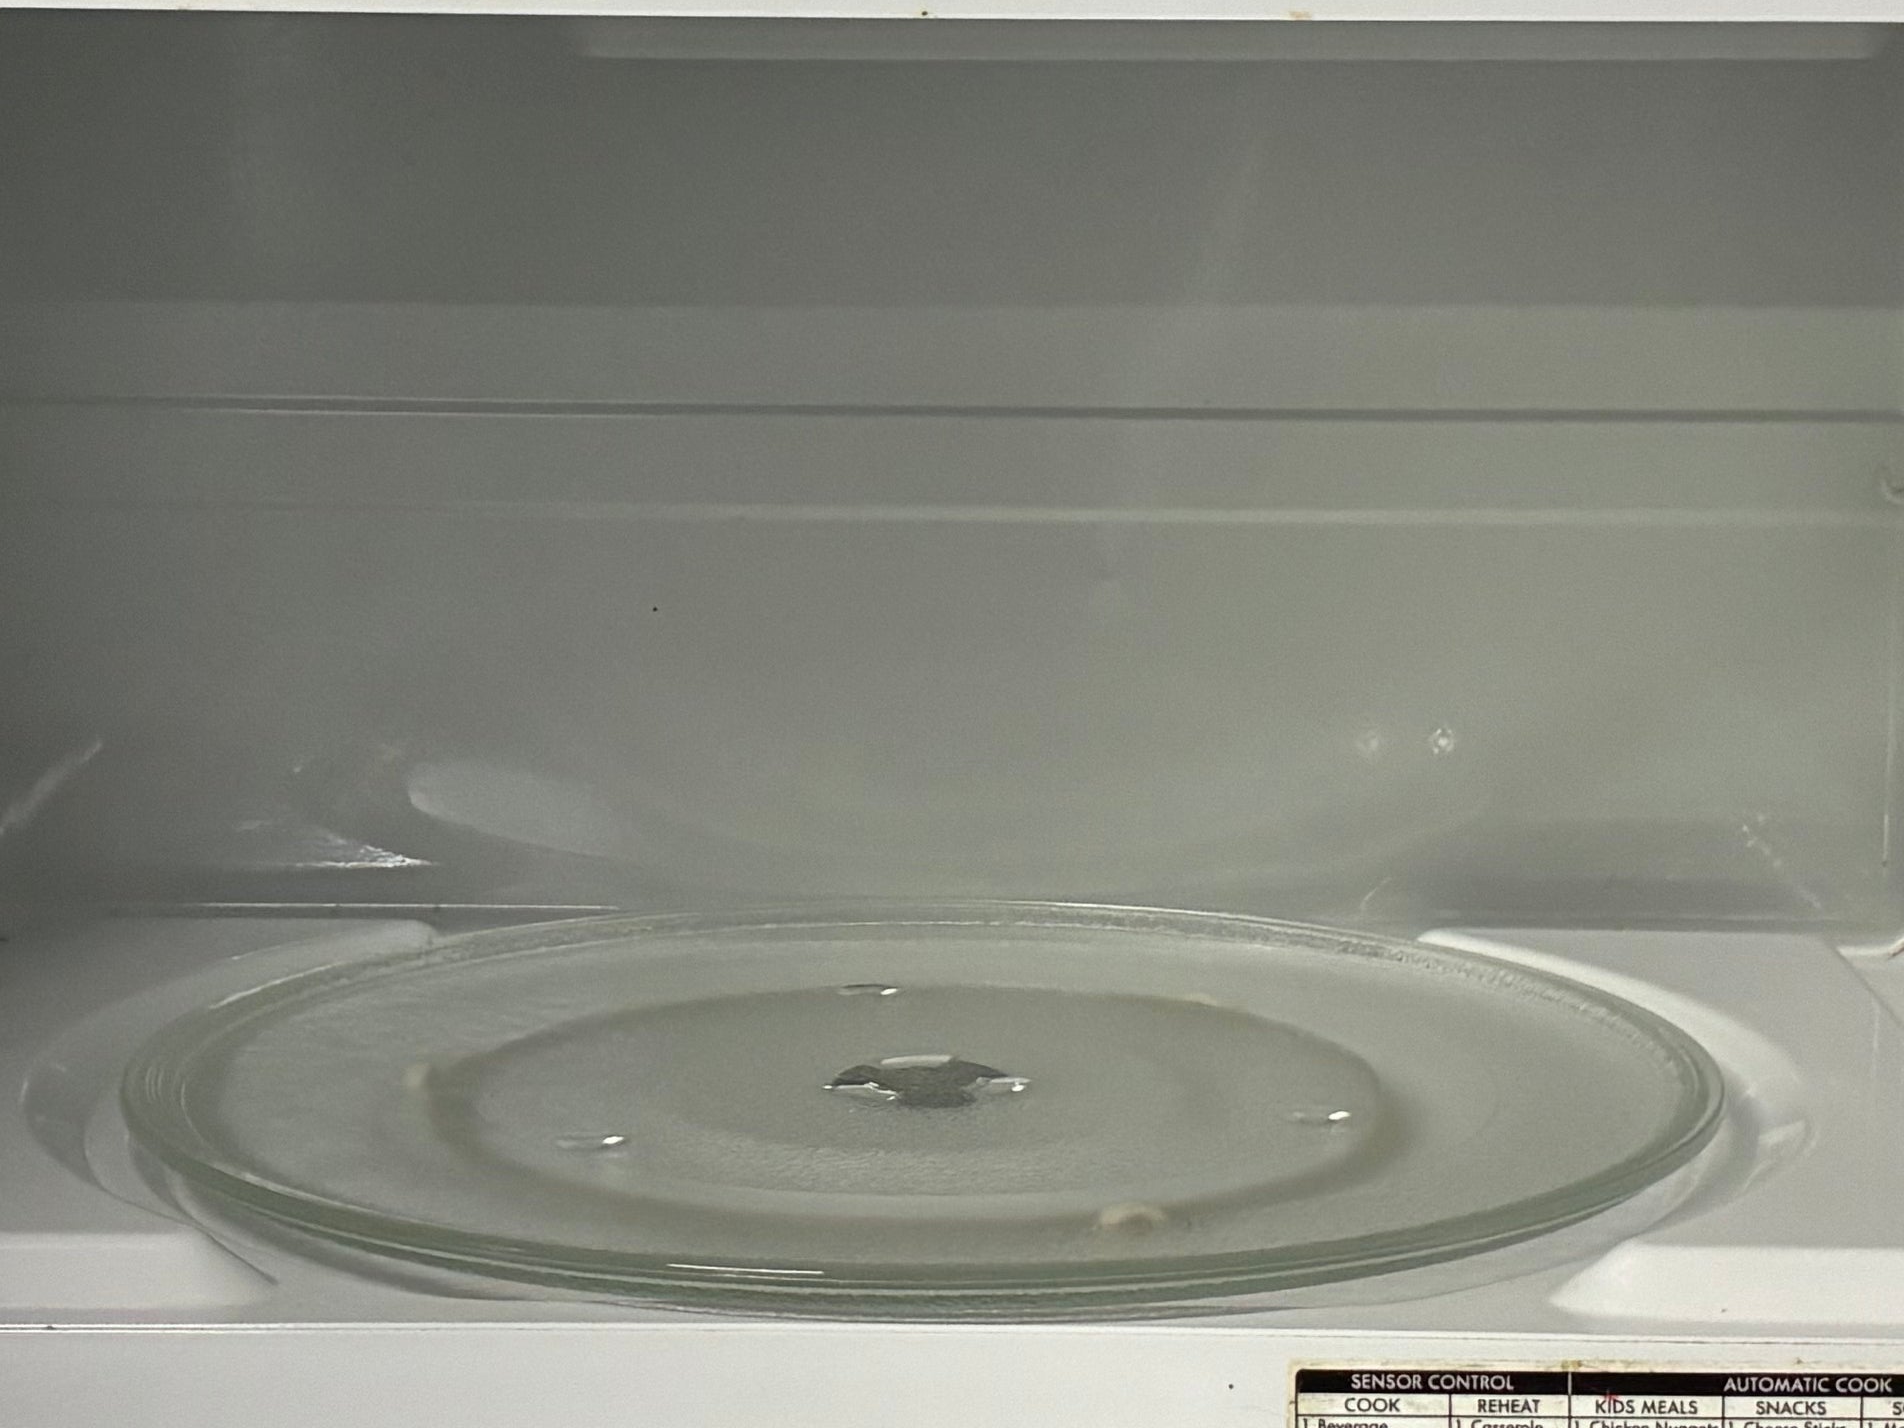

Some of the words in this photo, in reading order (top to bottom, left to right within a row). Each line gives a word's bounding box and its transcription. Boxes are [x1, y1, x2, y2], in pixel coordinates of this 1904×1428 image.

[1351, 1374, 1422, 1389] SENSOR
[1428, 1375, 1514, 1390] CONTROL
[1724, 1377, 1829, 1392] AUTOMATIC
[1836, 1377, 1892, 1392] COOK
[1345, 1398, 1400, 1412] COOK
[1478, 1399, 1540, 1413] REHEAT
[1596, 1399, 1635, 1414] KIDS
[1641, 1400, 1697, 1414] MEALS
[1756, 1401, 1826, 1415] SNACKS
